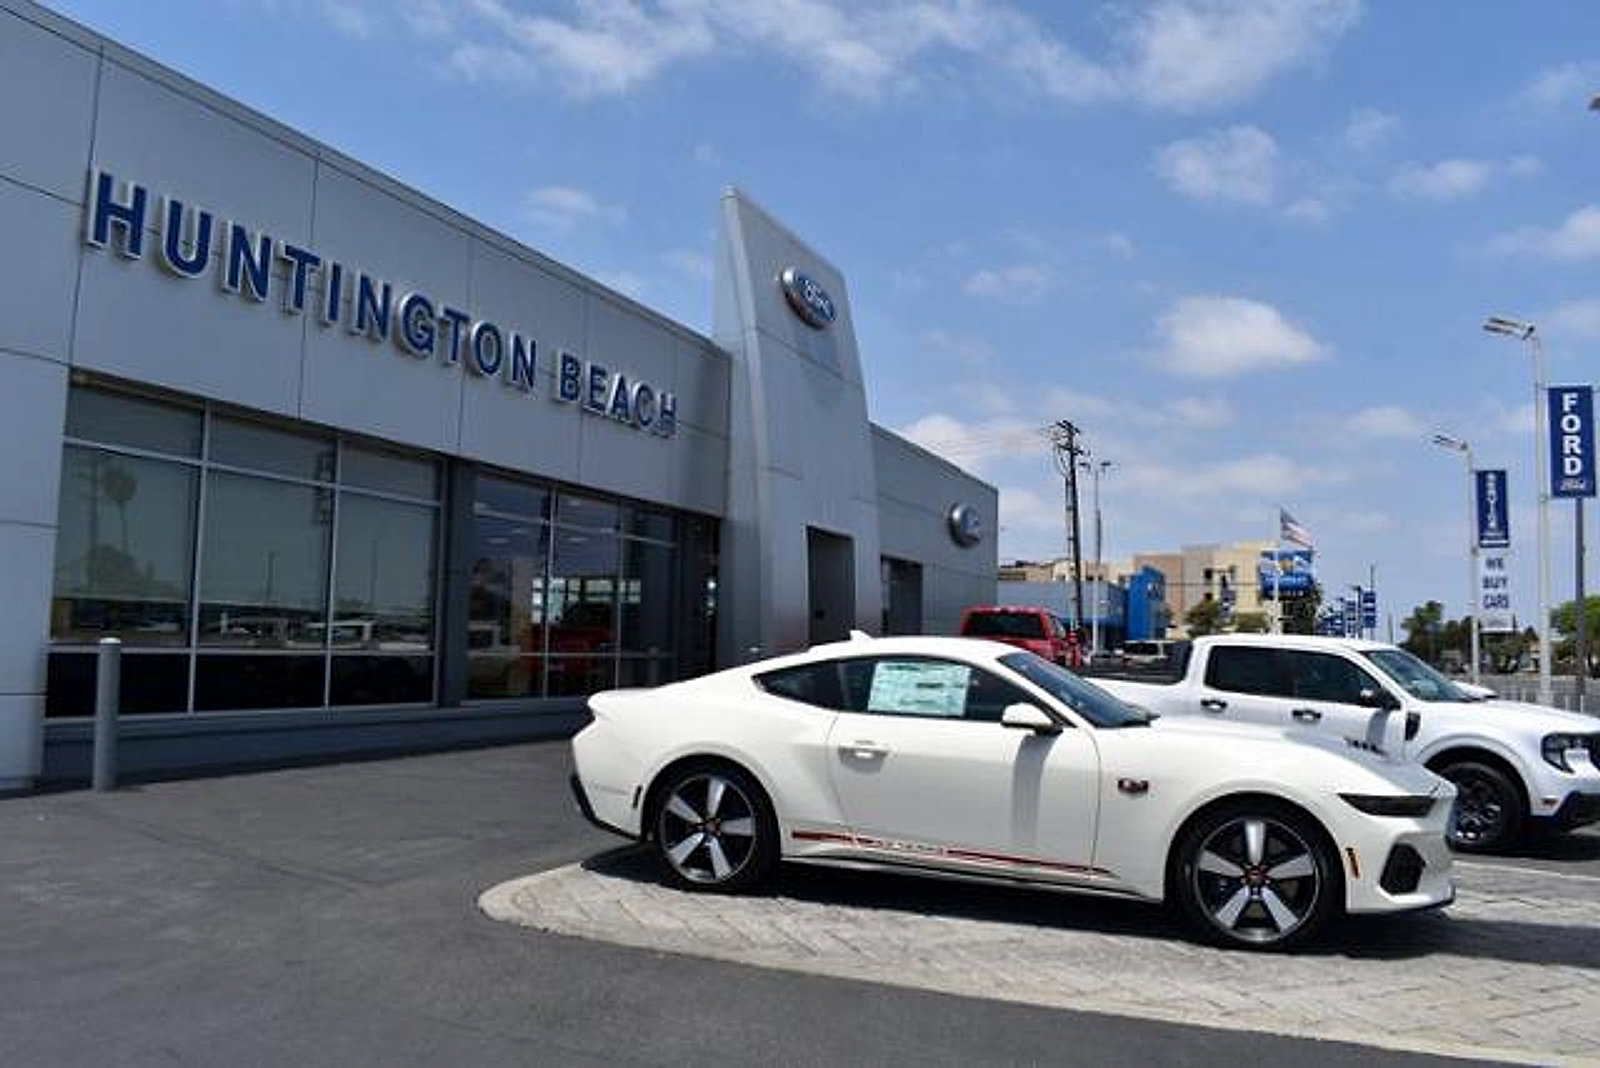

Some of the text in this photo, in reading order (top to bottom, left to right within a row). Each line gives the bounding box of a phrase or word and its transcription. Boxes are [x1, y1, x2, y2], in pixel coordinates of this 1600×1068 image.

[86, 168, 678, 437] HUNTINGTON BEACH
[1561, 392, 1582, 476] FORD
[1485, 557, 1504, 570] WE
[1482, 576, 1508, 589] BUY
[1483, 594, 1509, 609] CARS
